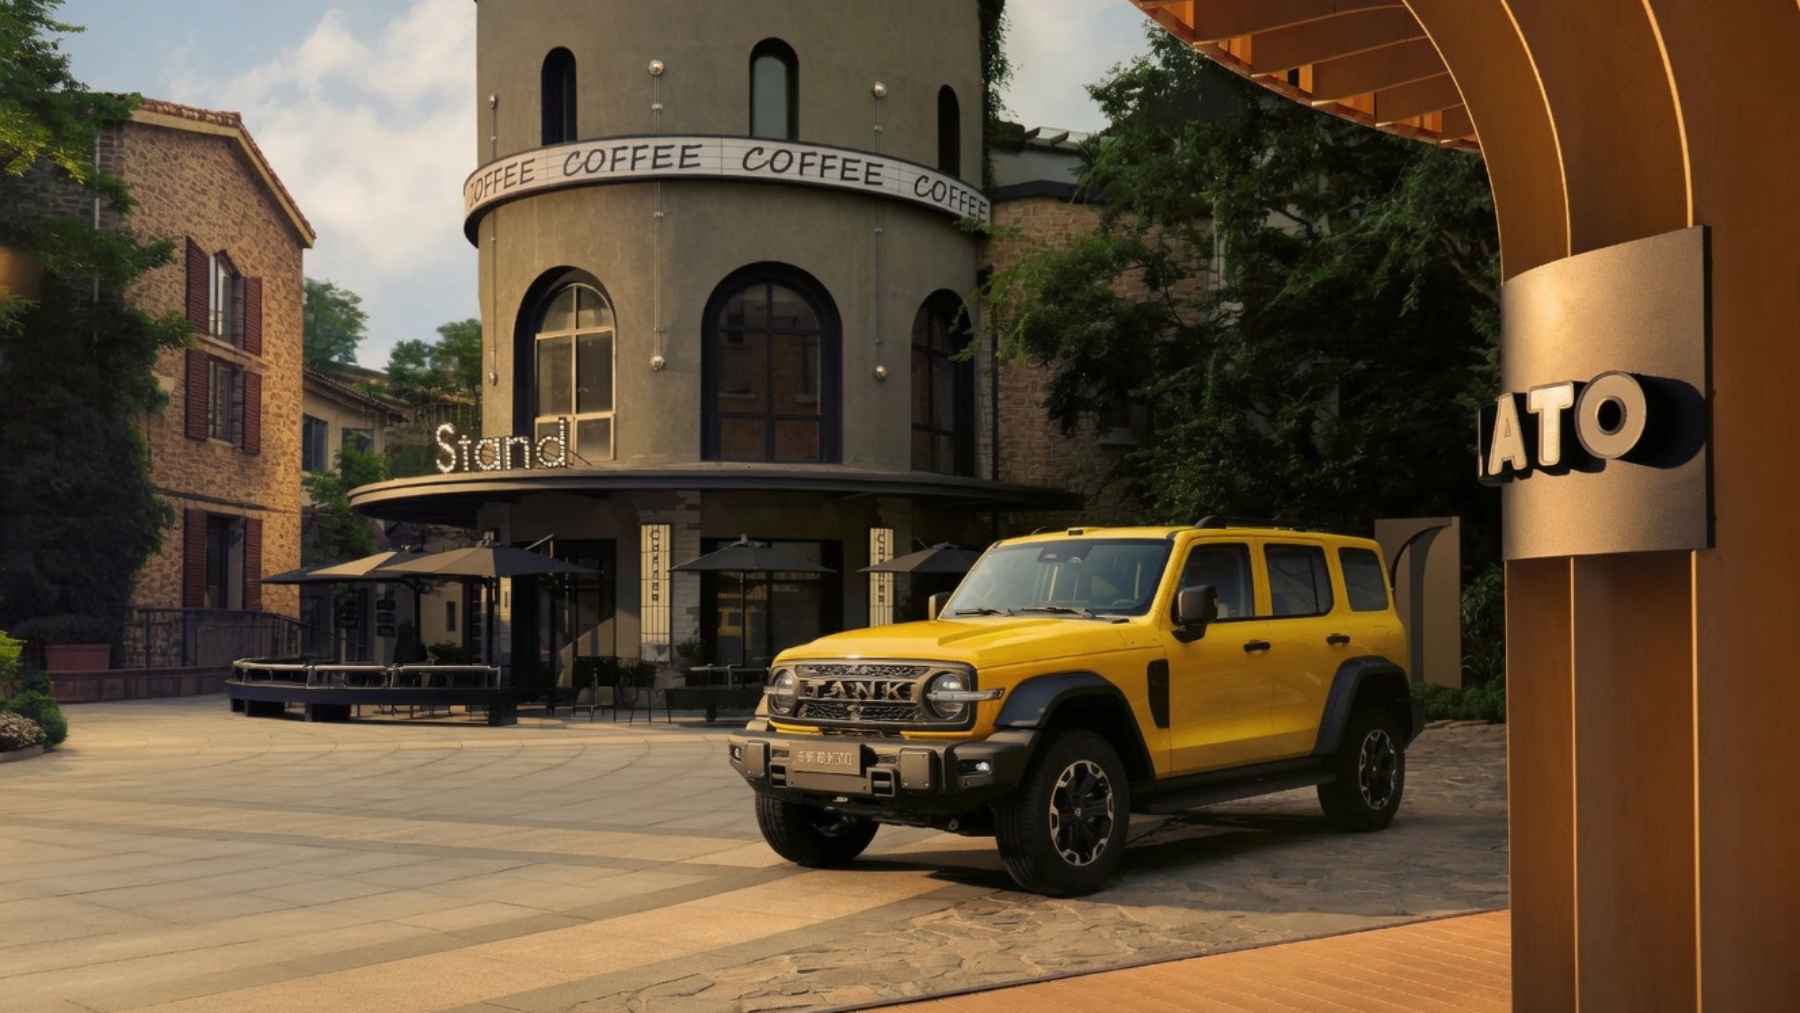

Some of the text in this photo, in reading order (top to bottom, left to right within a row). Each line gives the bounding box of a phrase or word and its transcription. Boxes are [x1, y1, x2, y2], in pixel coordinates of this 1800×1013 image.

[563, 143, 704, 177] COFFEE
[742, 146, 885, 187] COFFEE
[914, 175, 988, 222] COFFEE
[436, 417, 566, 473] Stand
[1479, 370, 1648, 477] ATO
[803, 679, 908, 701] TANK
